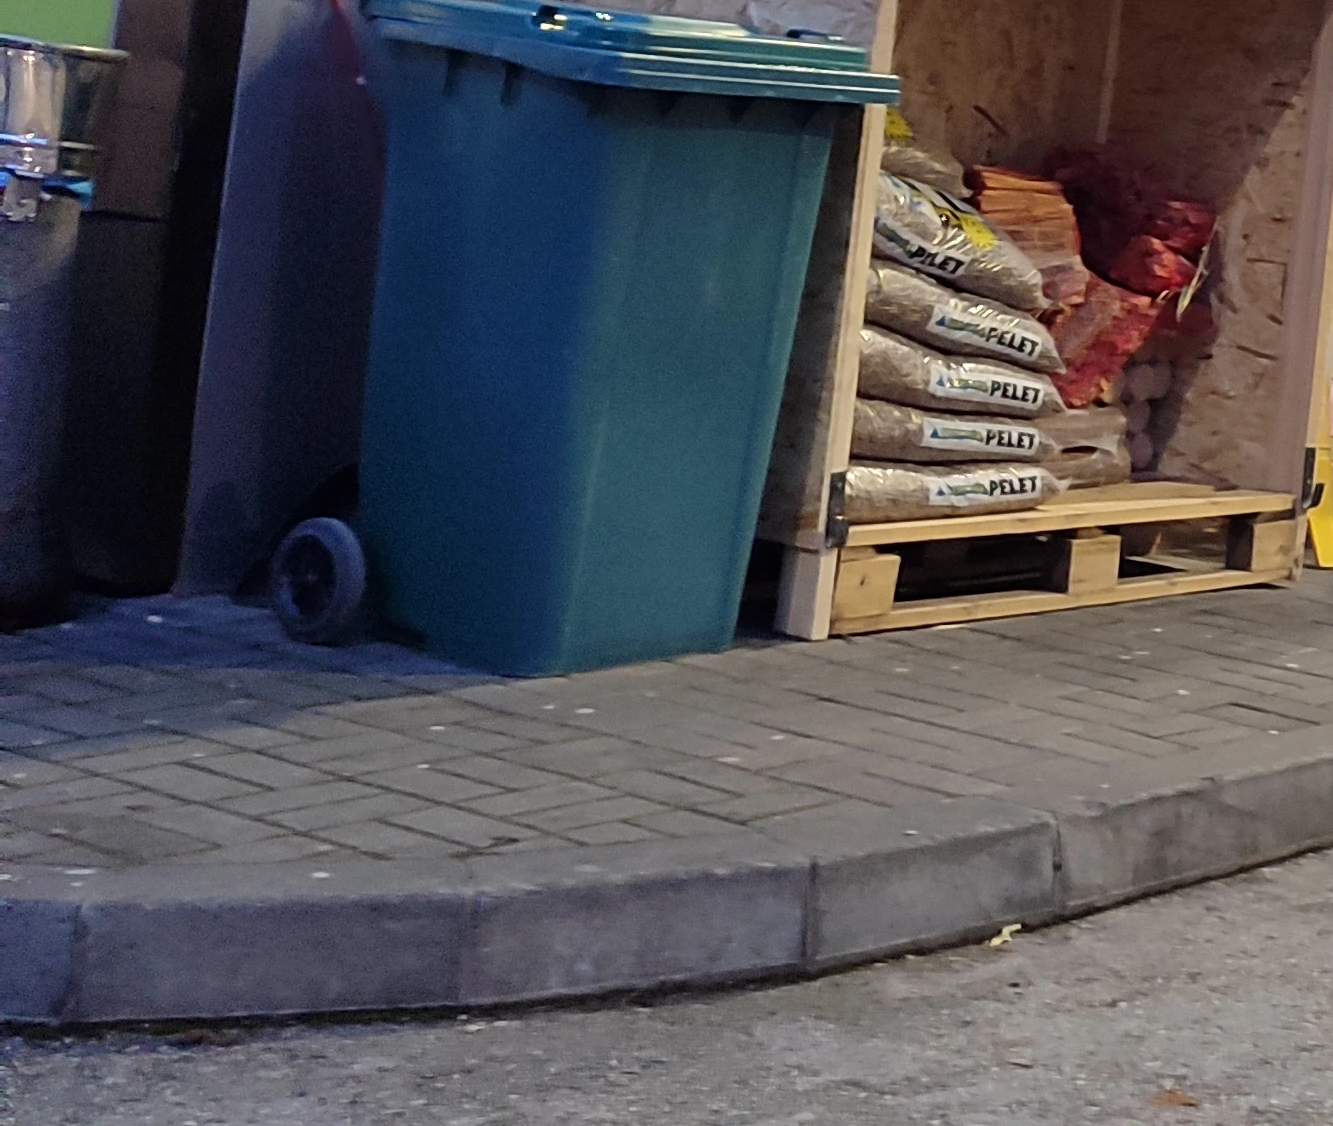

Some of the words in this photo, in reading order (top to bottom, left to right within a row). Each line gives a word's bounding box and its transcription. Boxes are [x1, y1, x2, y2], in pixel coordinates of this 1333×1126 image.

[985, 327, 1039, 356] PELET
[989, 380, 1040, 404] PELET
[985, 429, 1036, 450] PELET
[989, 476, 1038, 496] PELET
